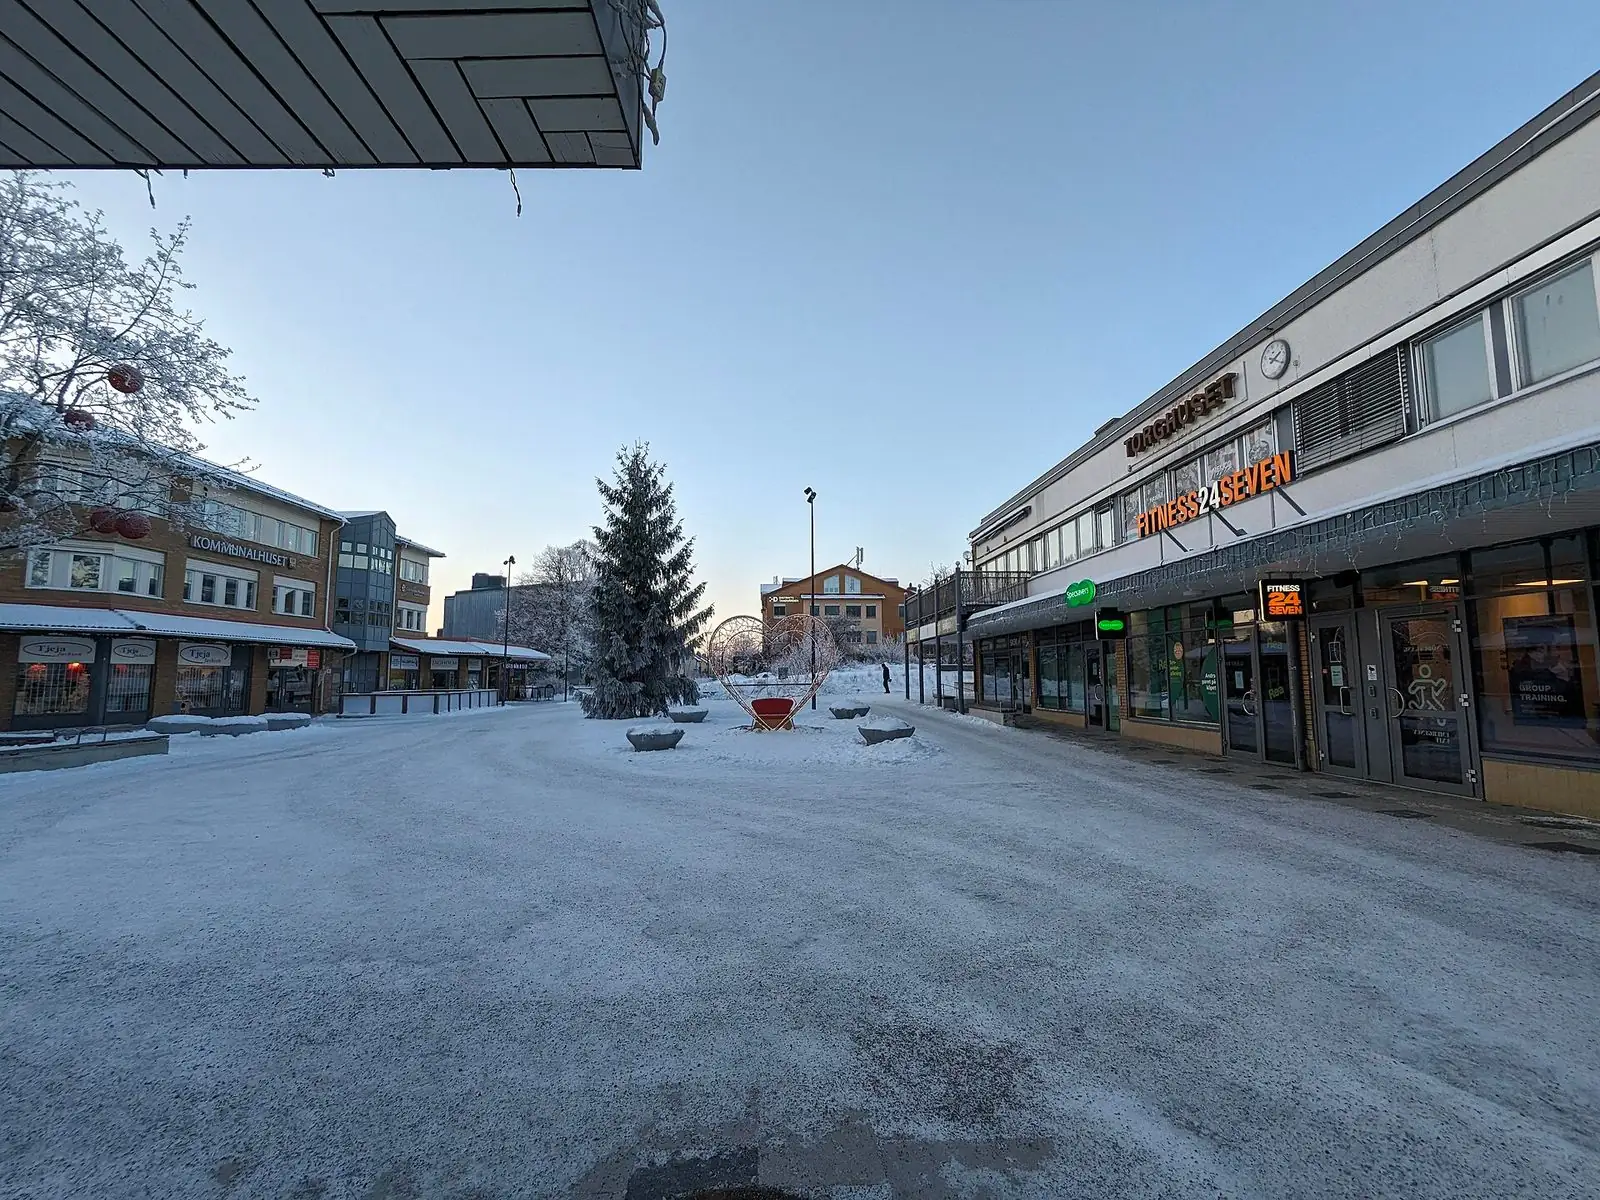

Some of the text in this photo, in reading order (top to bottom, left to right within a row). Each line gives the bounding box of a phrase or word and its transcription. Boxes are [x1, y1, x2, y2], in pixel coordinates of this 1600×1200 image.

[1124, 373, 1238, 457] TORGHUSET
[1135, 450, 1296, 538] FITNESS24SEVEN
[192, 535, 288, 567] KOMMUNALHUSET
[1266, 584, 1300, 593] FITNESS
[1268, 592, 1301, 606] 24
[1268, 605, 1302, 615] SEVEN
[37, 645, 67, 654] Tjeja
[189, 649, 211, 659] Tjeja
[1519, 684, 1551, 692] GROUP
[1519, 693, 1568, 703] TRAINING.
